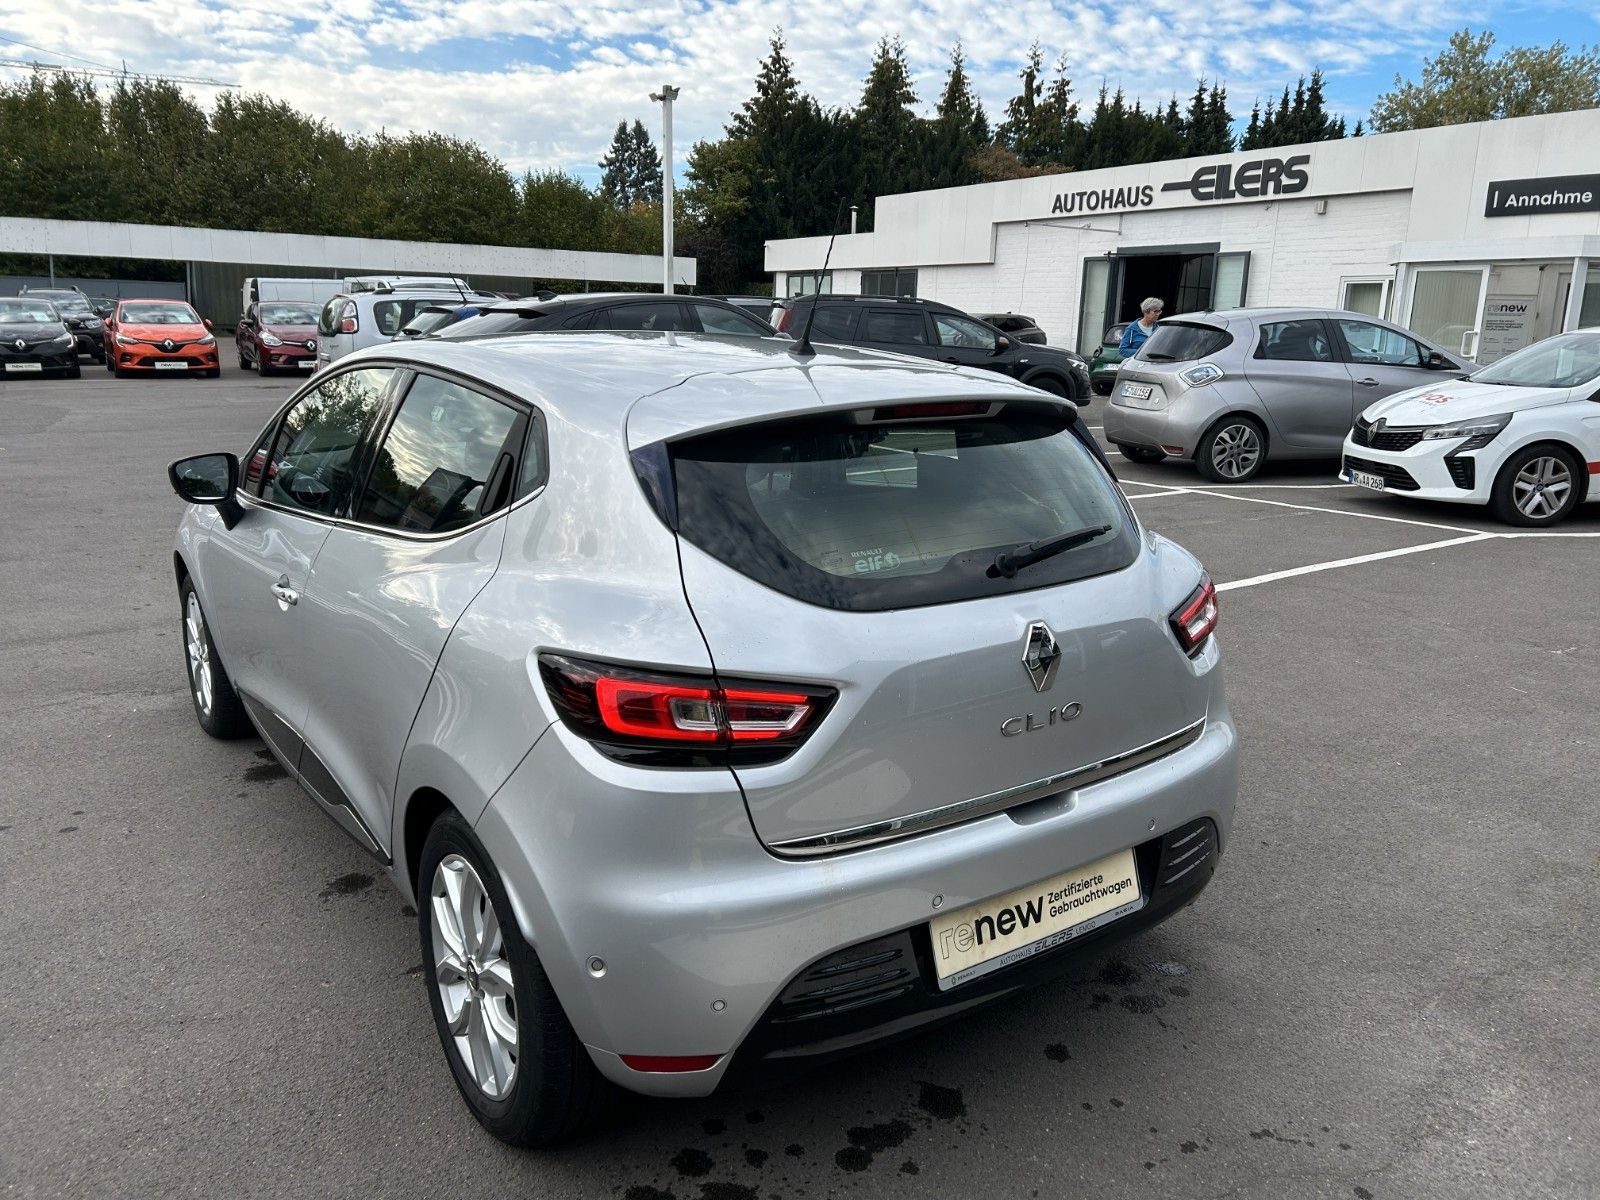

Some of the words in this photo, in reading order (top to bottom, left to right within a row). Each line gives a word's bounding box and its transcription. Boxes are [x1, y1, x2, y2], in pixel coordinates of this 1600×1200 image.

[1051, 184, 1154, 214] AUTOHAUS
[1161, 154, 1311, 201] EILERS
[1504, 189, 1593, 208] Annahme
[1487, 304, 1527, 312] renew
[1370, 477, 1383, 490] 268
[850, 547, 883, 558] RENAULT
[854, 555, 882, 573] elf
[1001, 701, 1083, 737] CLIO
[1047, 874, 1103, 905] Zertifizierte
[1049, 878, 1132, 917] Gebrauchtwagen
[939, 895, 1044, 960] renew
[1000, 947, 1032, 967] AUTOHAUS
[1033, 928, 1074, 953] EILERS
